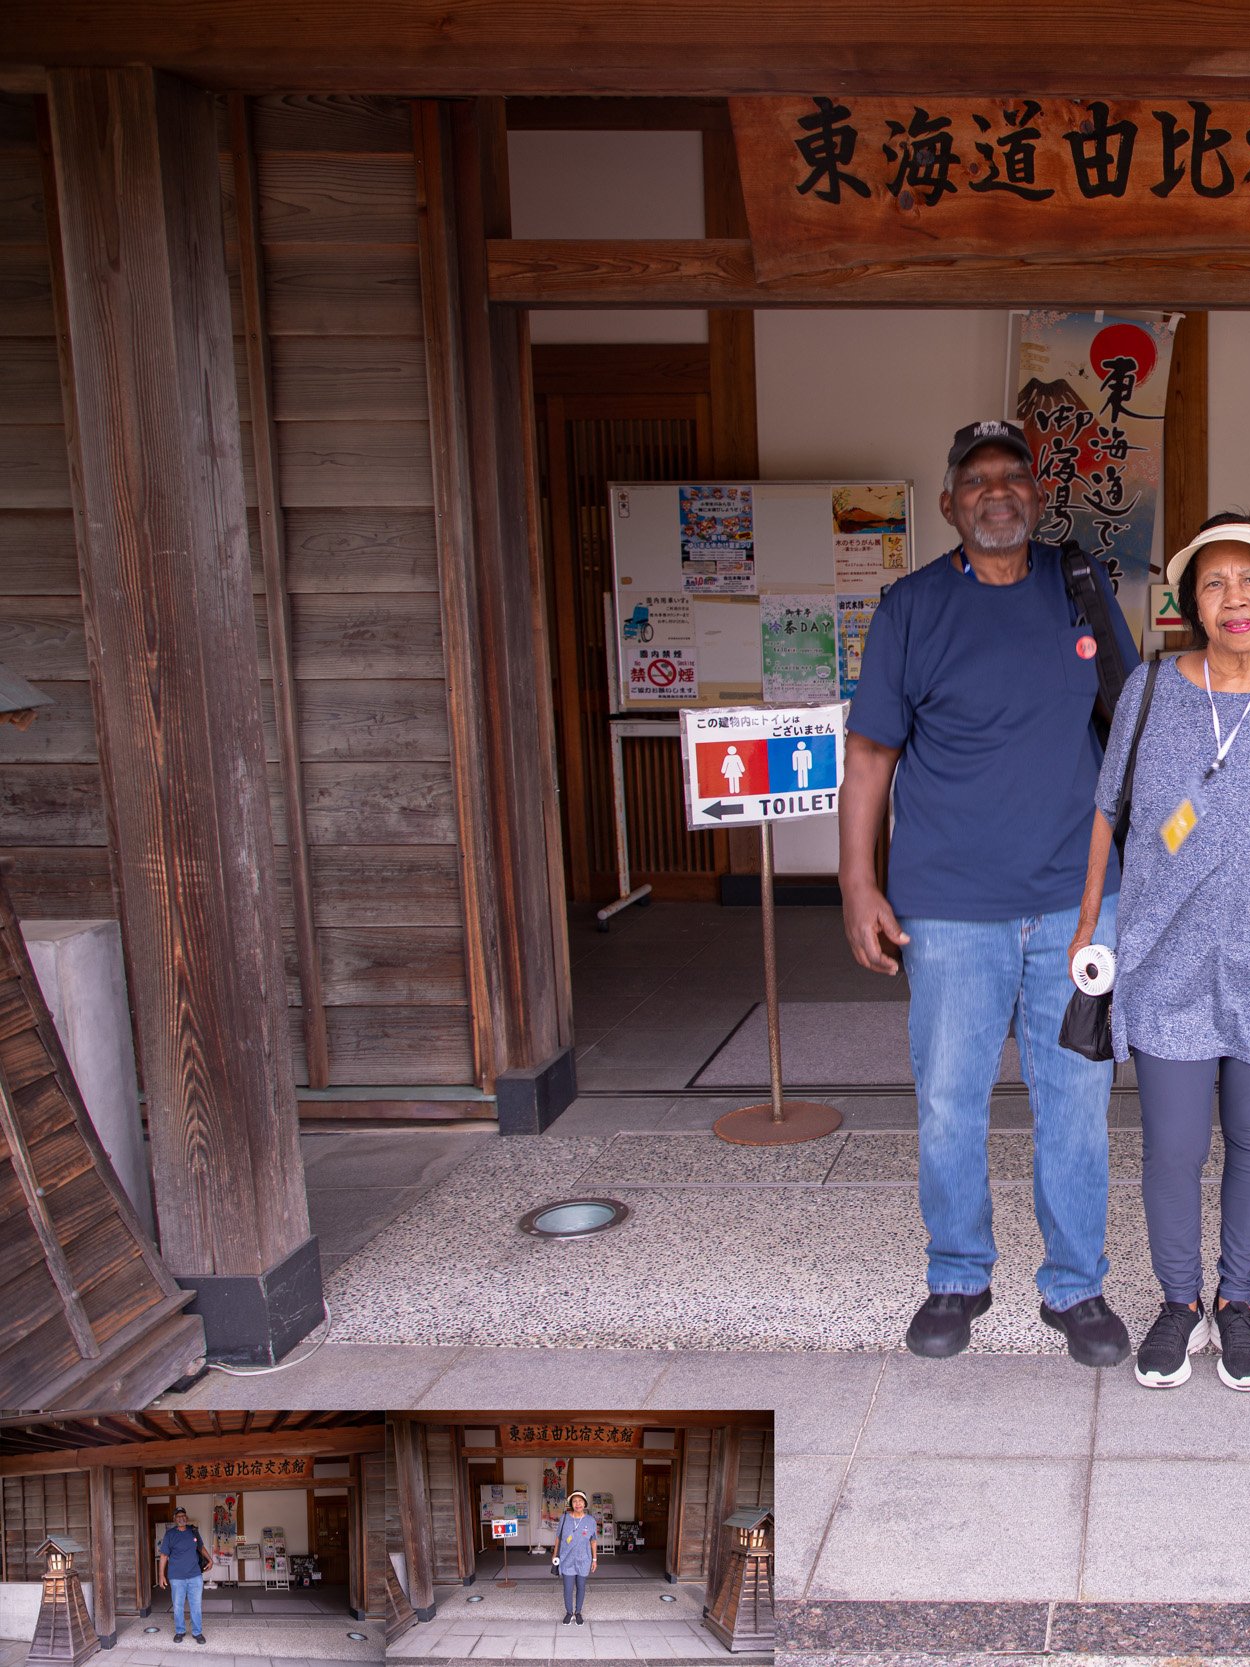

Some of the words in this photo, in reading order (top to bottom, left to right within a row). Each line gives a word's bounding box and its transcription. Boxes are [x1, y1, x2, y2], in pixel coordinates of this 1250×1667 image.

[630, 667, 647, 683] 禁
[678, 667, 695, 683] 煙
[697, 714, 800, 729] この建物内にトイレは
[772, 723, 835, 737] ございません
[758, 793, 837, 816] TOILET
[510, 1424, 634, 1443] 東海道由比宿交流館
[184, 1458, 306, 1480] 東海道由比宿交流館
